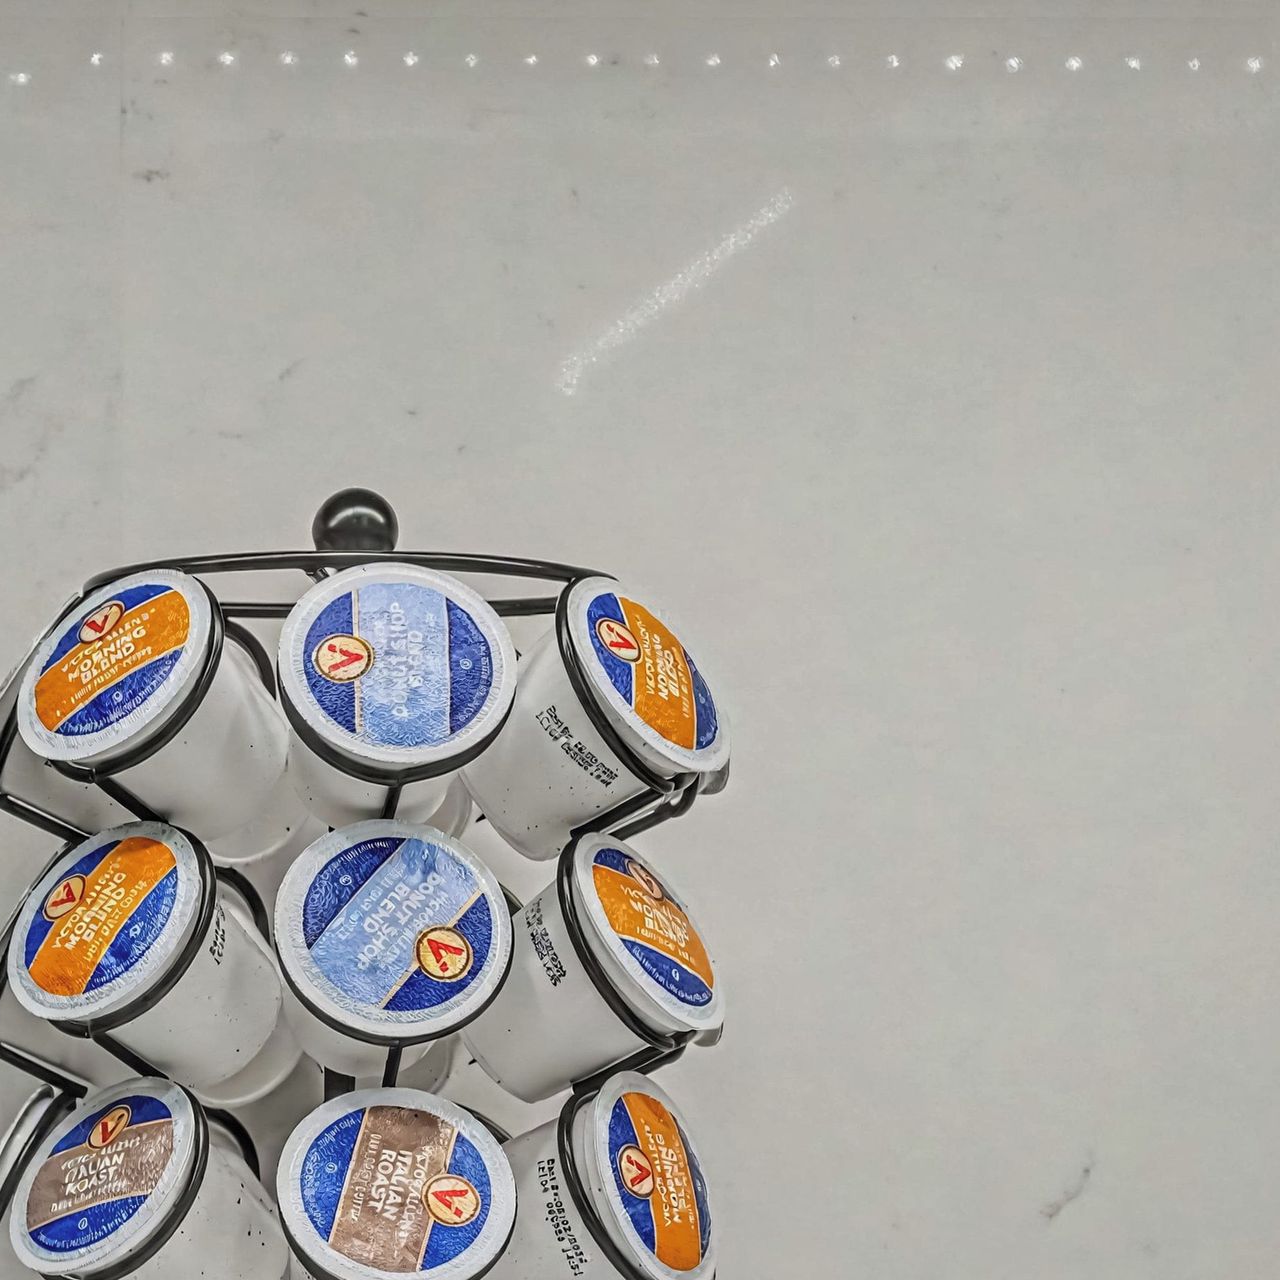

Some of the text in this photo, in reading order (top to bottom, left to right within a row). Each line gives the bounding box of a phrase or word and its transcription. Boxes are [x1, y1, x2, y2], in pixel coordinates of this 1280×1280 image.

[363, 881, 411, 933] BLEND
[398, 872, 446, 924] DONUT
[356, 928, 398, 970] SHOP
[367, 1150, 396, 1214] ROAST
[382, 1150, 412, 1221] ITALIAN
